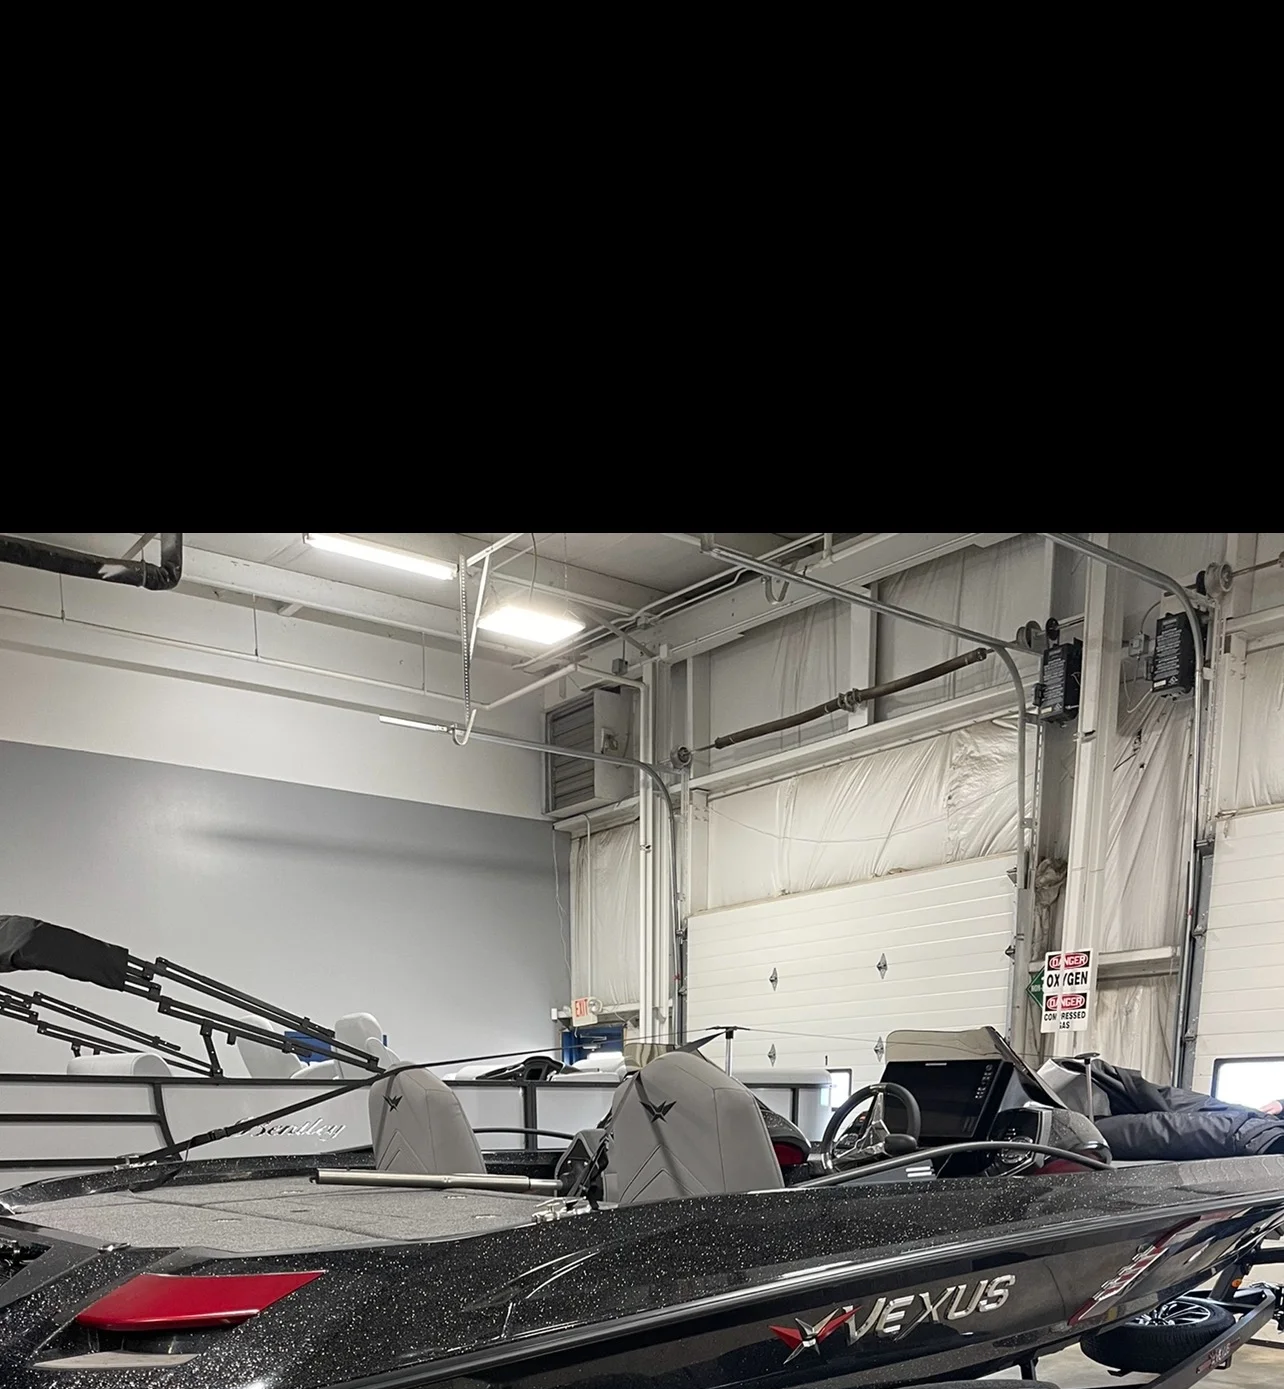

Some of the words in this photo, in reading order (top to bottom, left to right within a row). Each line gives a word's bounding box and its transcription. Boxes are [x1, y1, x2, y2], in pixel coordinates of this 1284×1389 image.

[575, 999, 588, 1017] EXIT
[1044, 1011, 1086, 1021] COMRESSED
[233, 1117, 346, 1142] Bentley
[843, 1274, 1016, 1346] VEXUS
